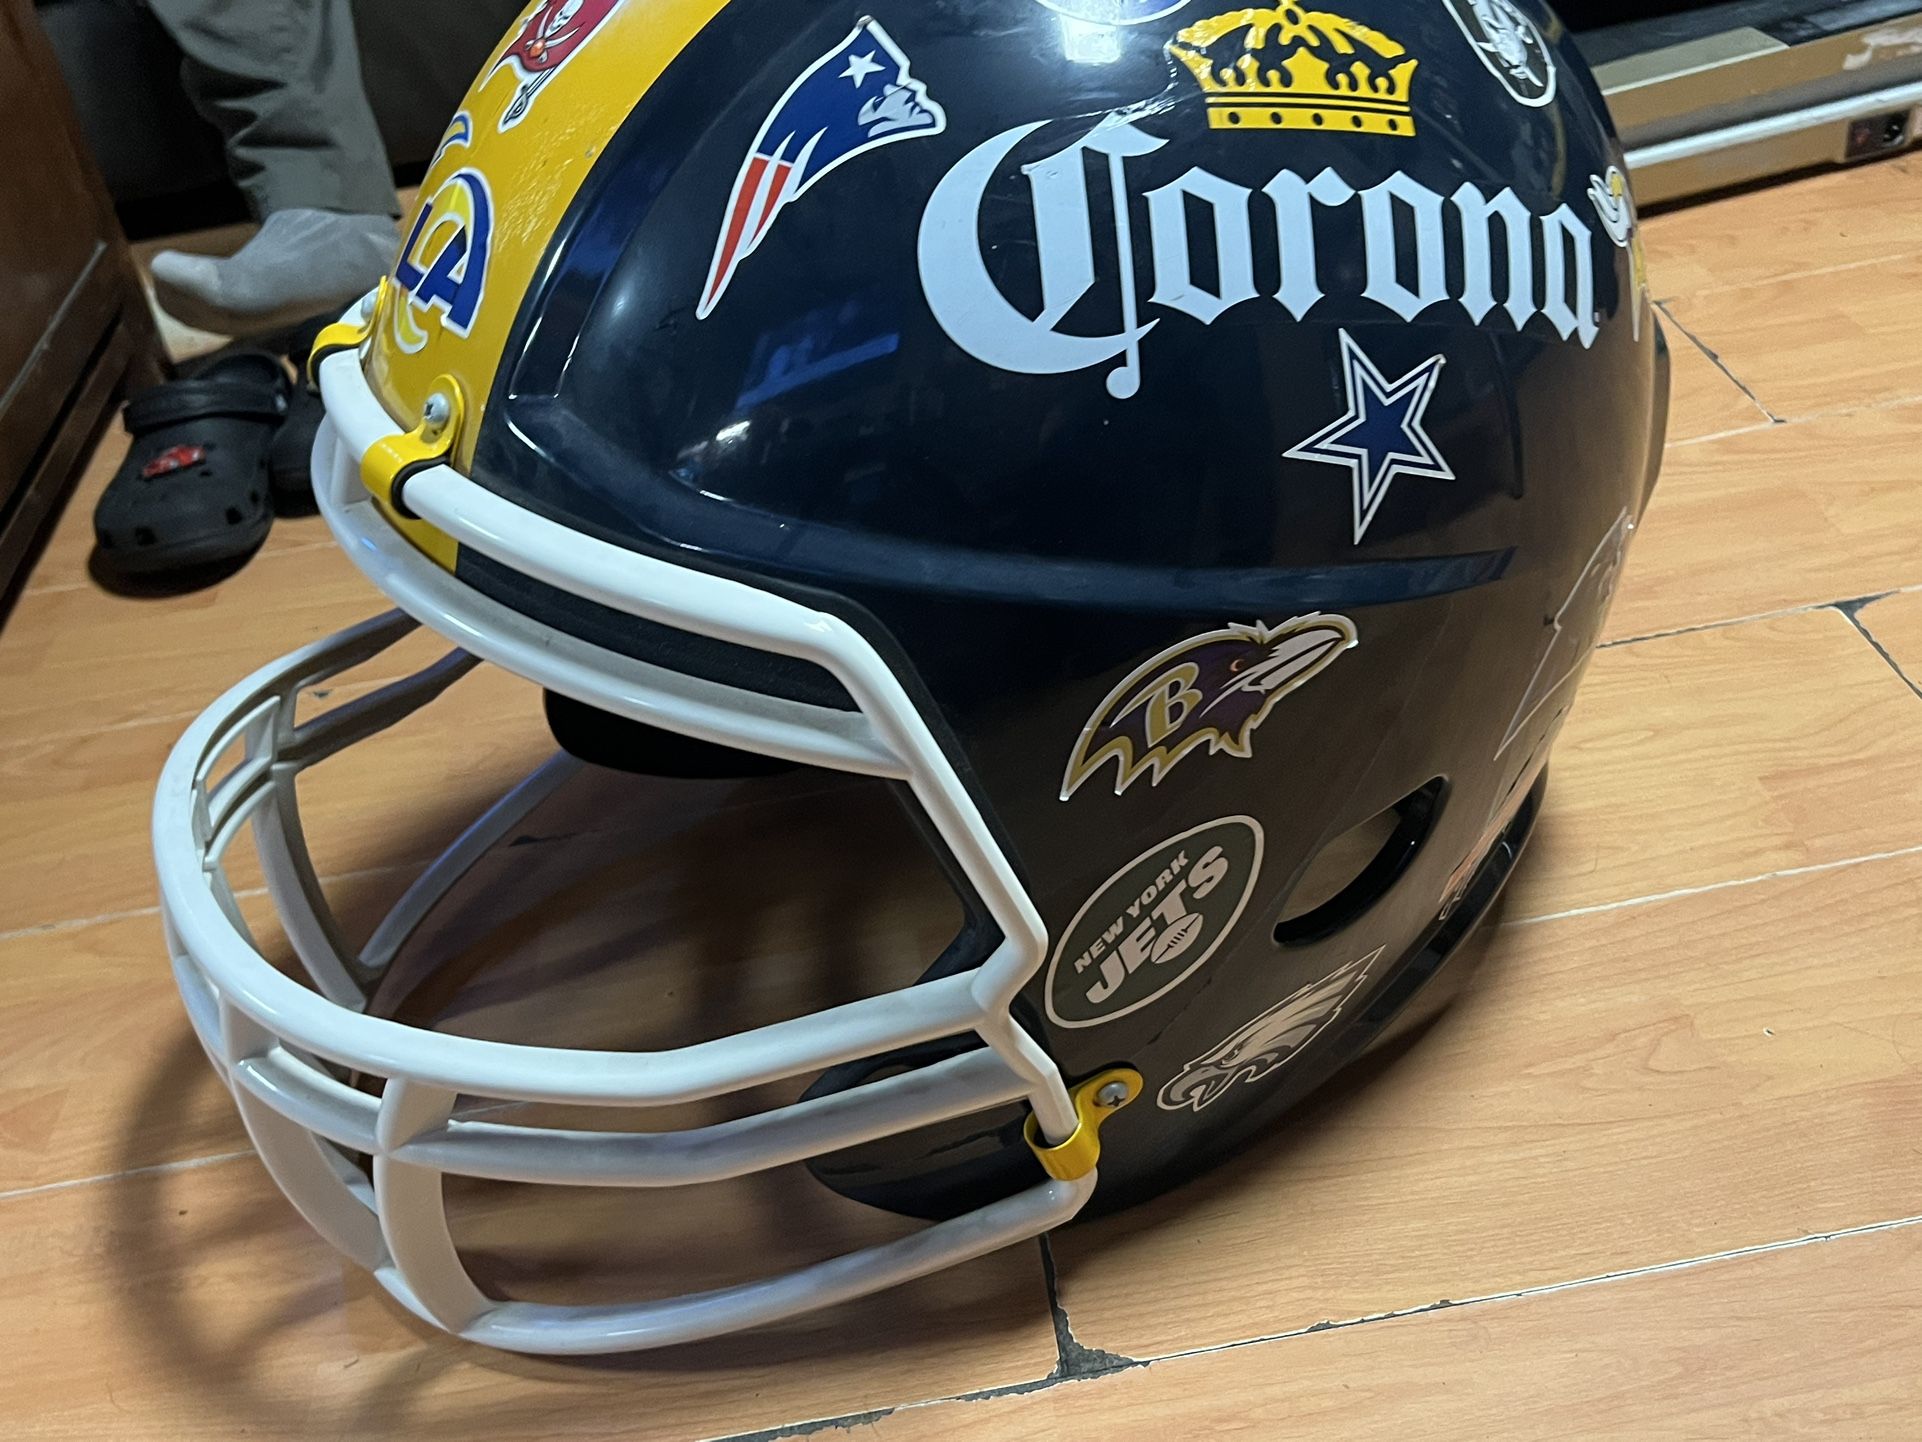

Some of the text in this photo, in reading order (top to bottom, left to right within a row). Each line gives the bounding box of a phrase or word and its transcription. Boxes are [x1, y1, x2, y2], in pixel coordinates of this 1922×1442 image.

[394, 169, 493, 333] LA
[918, 113, 1600, 399] Corona
[1110, 661, 1203, 748] B
[1073, 850, 1189, 974] NEW YORK
[1085, 845, 1229, 1004] JETS
